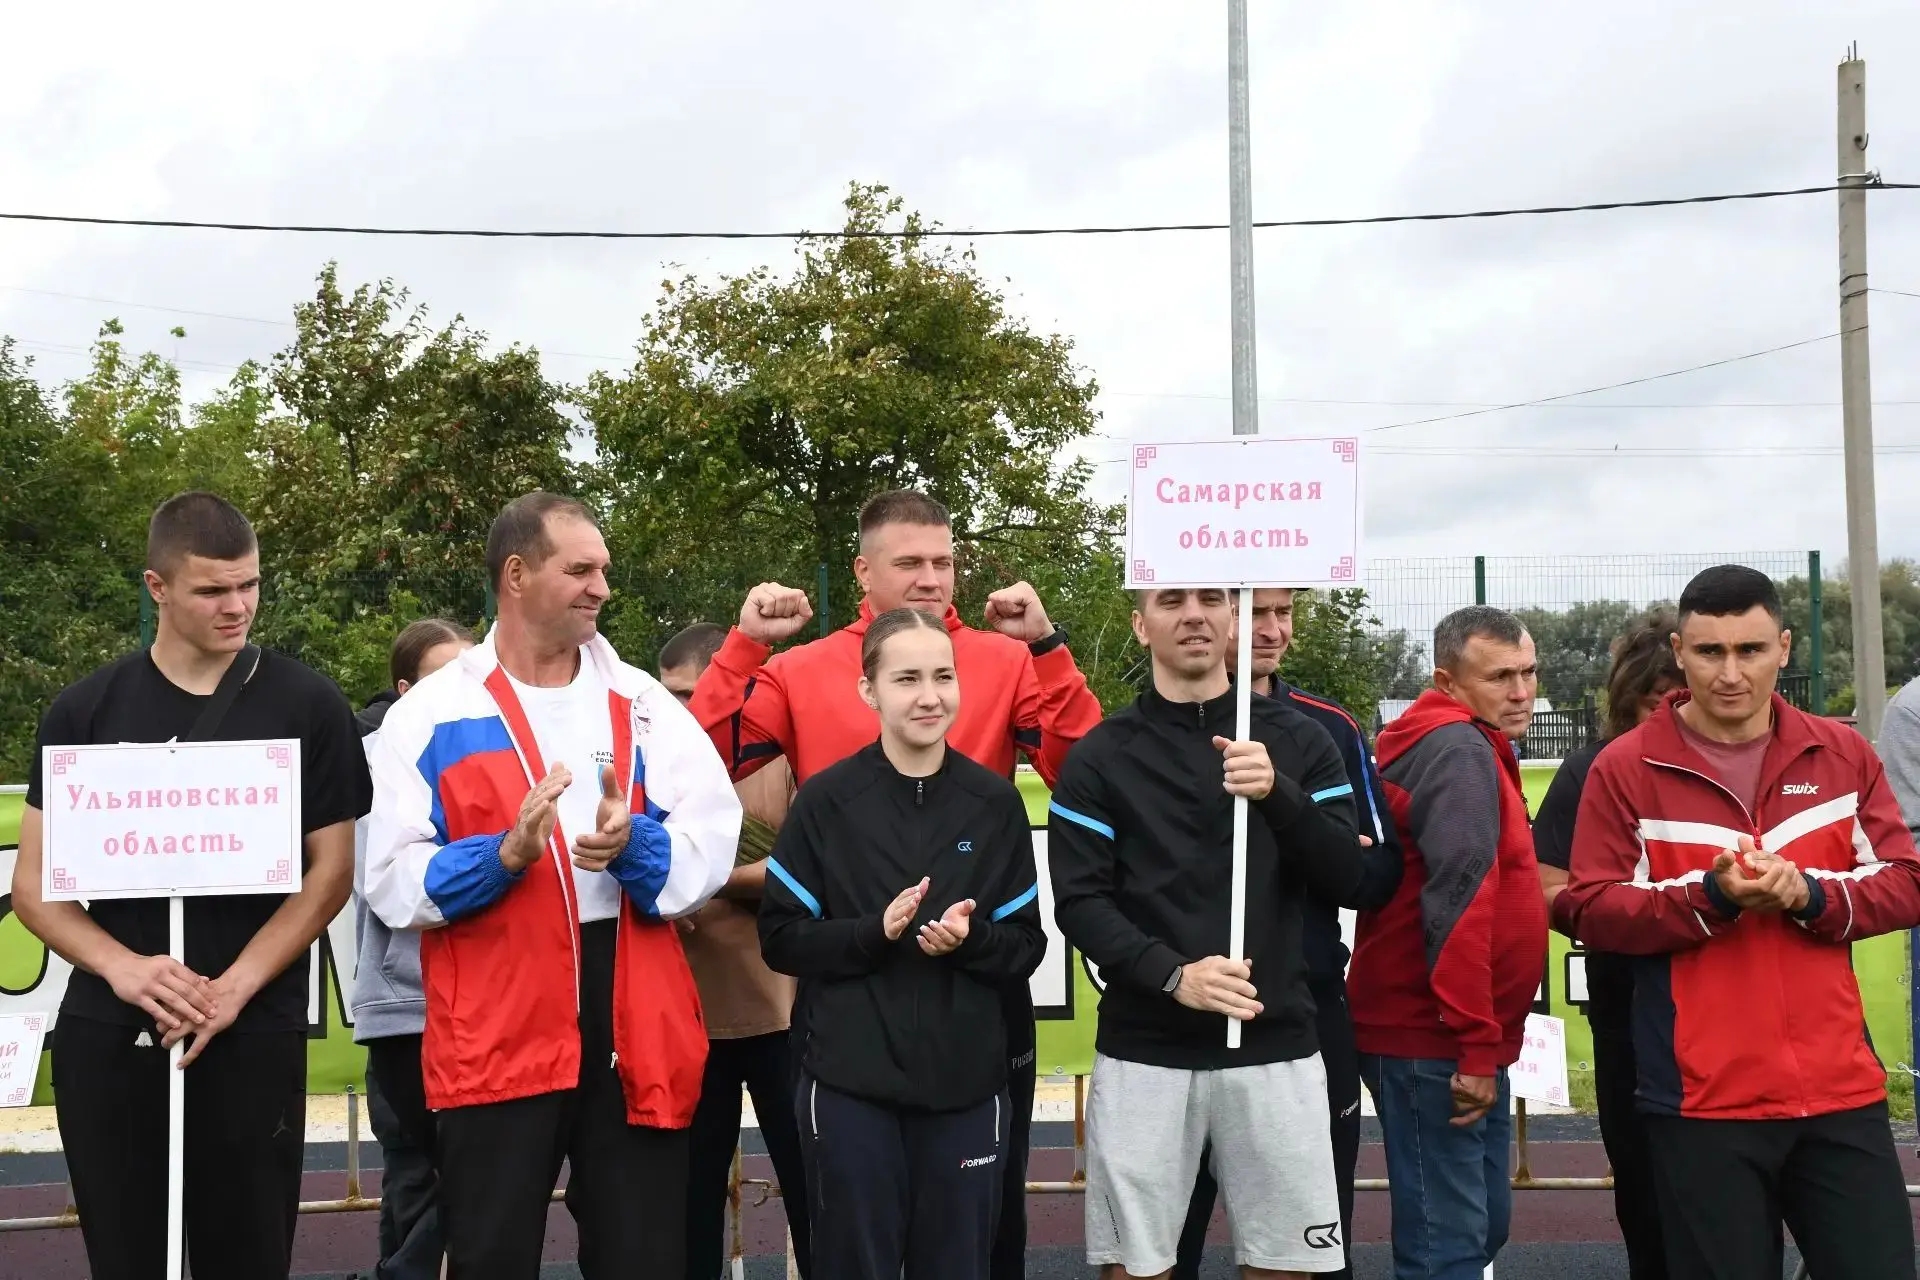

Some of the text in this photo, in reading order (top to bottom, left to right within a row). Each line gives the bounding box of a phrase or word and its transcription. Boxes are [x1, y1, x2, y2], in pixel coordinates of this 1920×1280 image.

[1156, 477, 1322, 510] Самарская
[1179, 524, 1309, 549] область
[66, 784, 279, 811] Ульяновская
[103, 830, 244, 857] область
[960, 1154, 997, 1169] FORWARD
